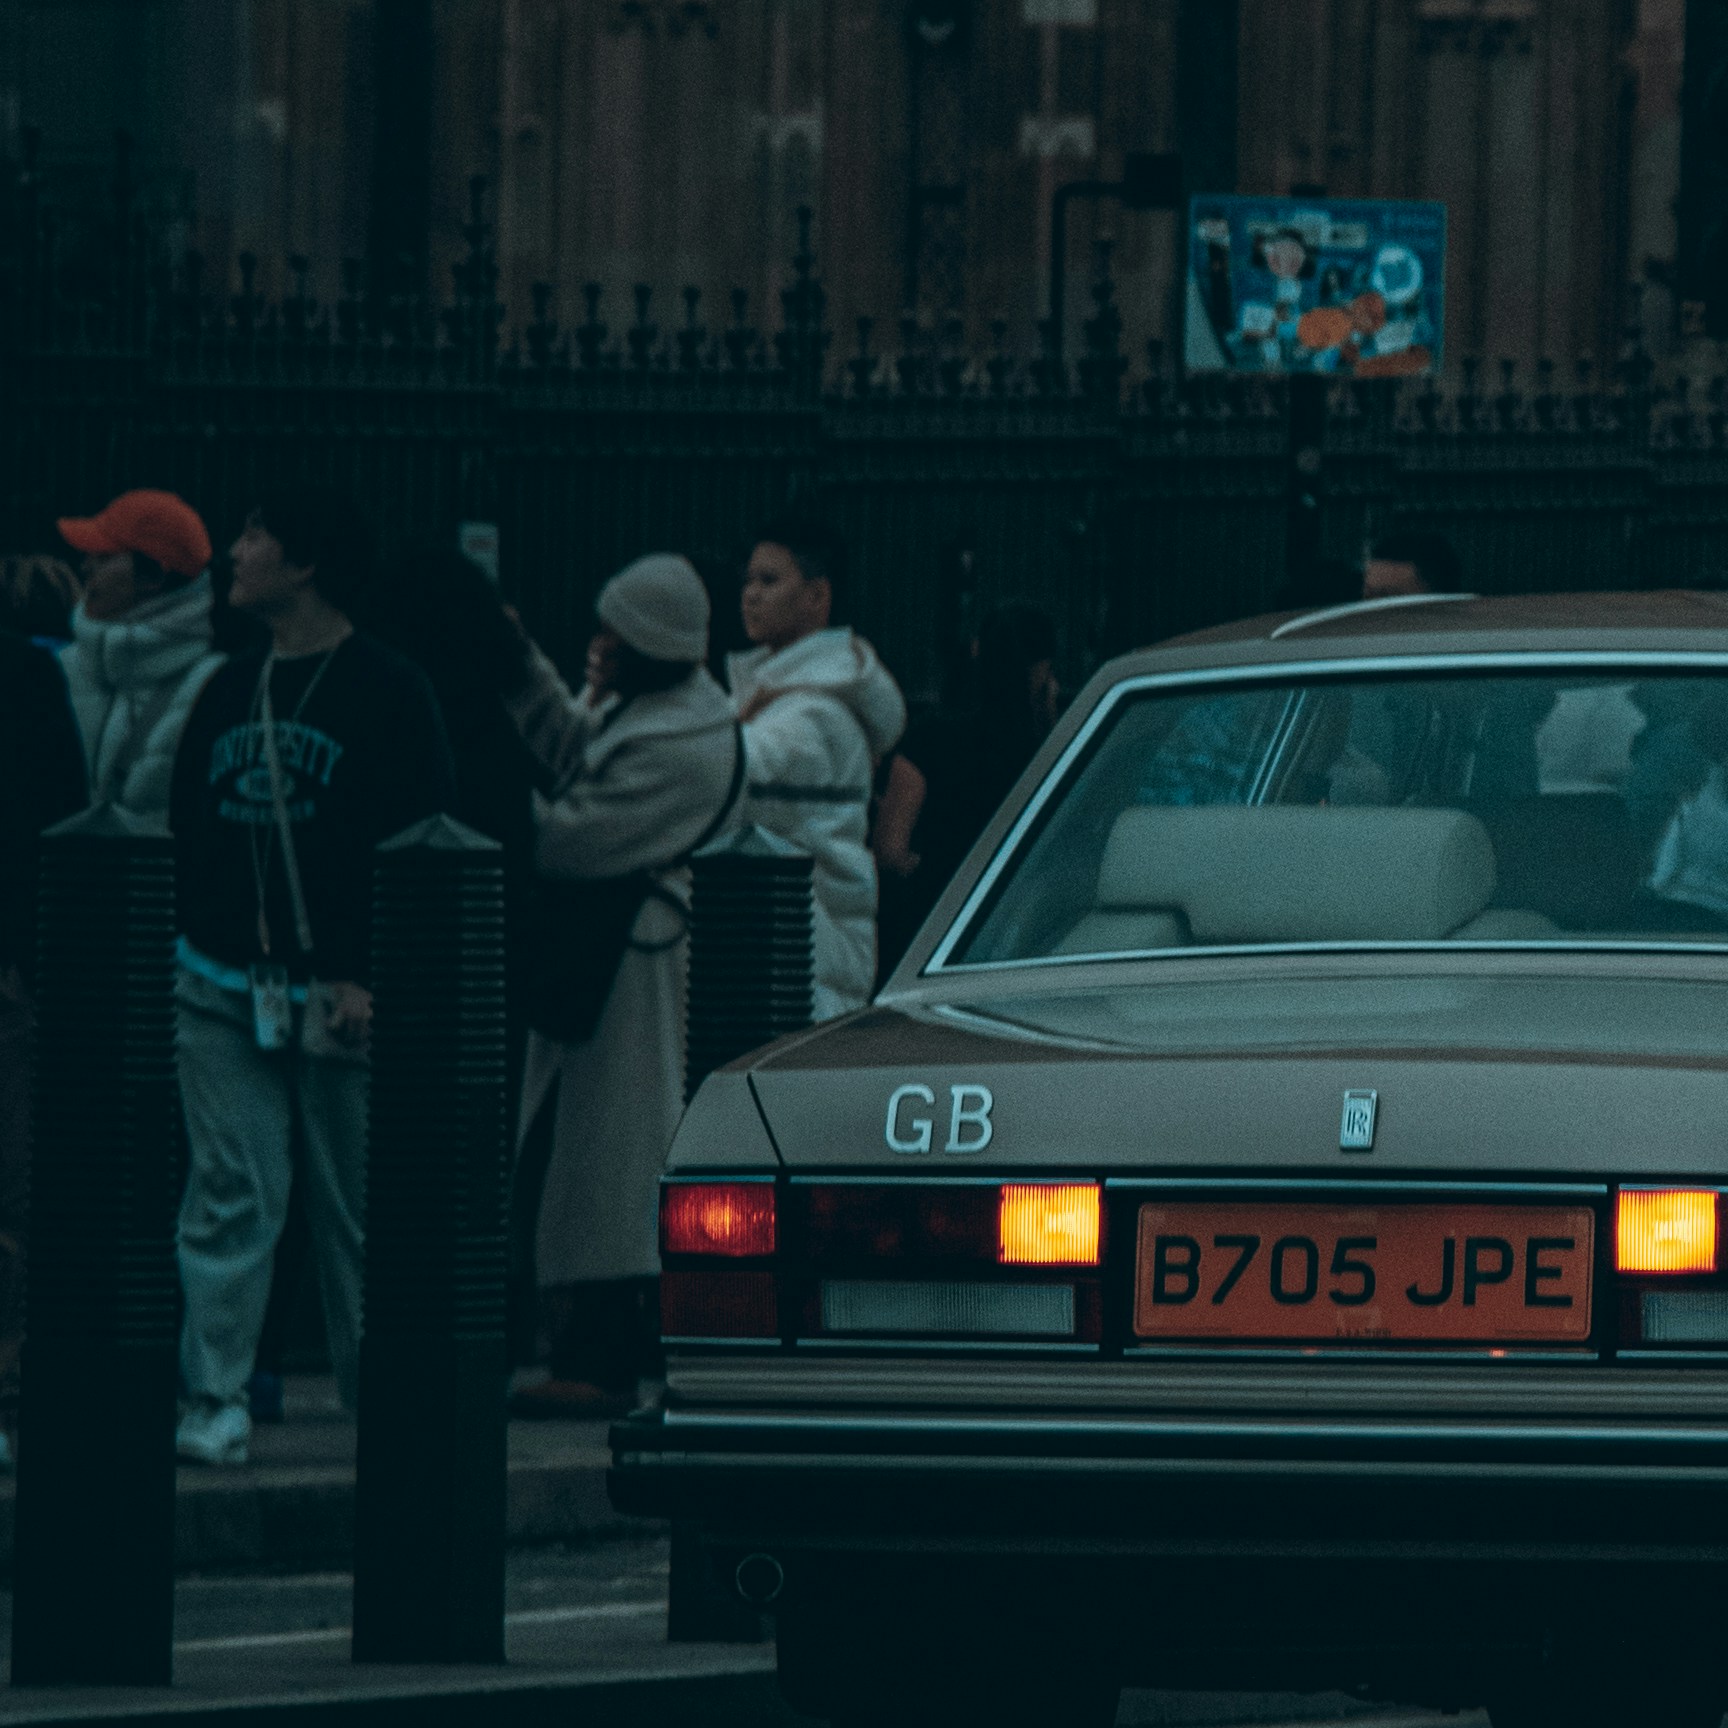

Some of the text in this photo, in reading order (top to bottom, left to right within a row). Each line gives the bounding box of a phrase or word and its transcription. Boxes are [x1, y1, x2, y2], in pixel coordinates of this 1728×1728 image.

[209, 720, 344, 786] UNIVRSITY
[884, 1083, 994, 1152] GB
[1151, 1232, 1576, 1309] B705 JPE
